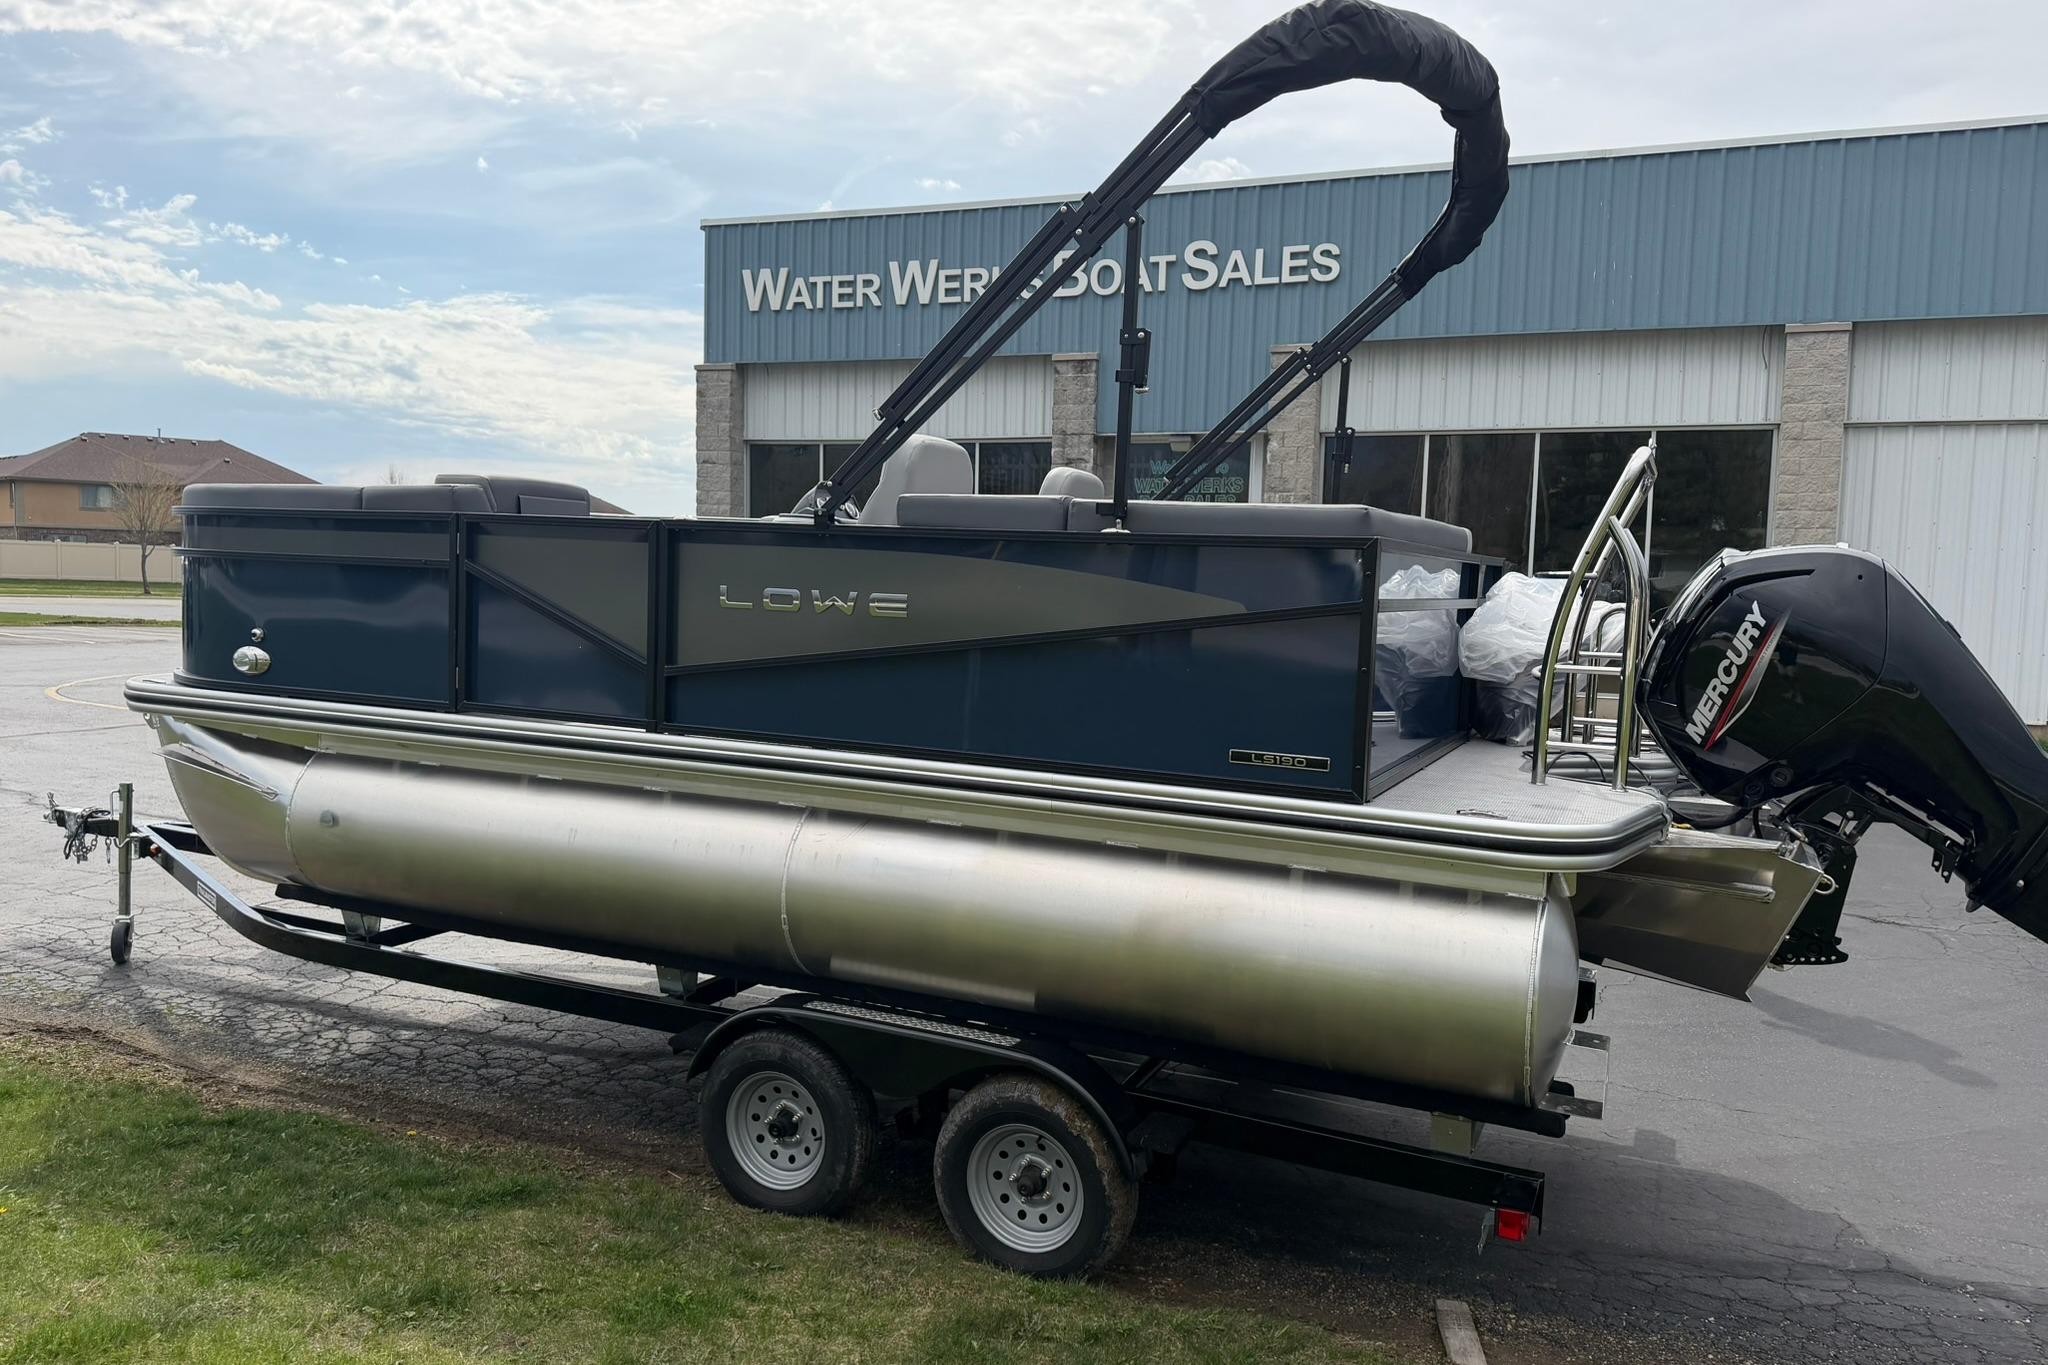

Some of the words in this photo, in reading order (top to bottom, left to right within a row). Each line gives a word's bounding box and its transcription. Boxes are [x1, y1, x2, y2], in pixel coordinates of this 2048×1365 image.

[742, 267, 882, 311] WATER
[889, 258, 1044, 305] WER
[1181, 240, 1341, 290] SALES
[720, 585, 907, 617] LOWE
[1685, 600, 1767, 744] MERCURY
[1251, 753, 1307, 767] LS190
